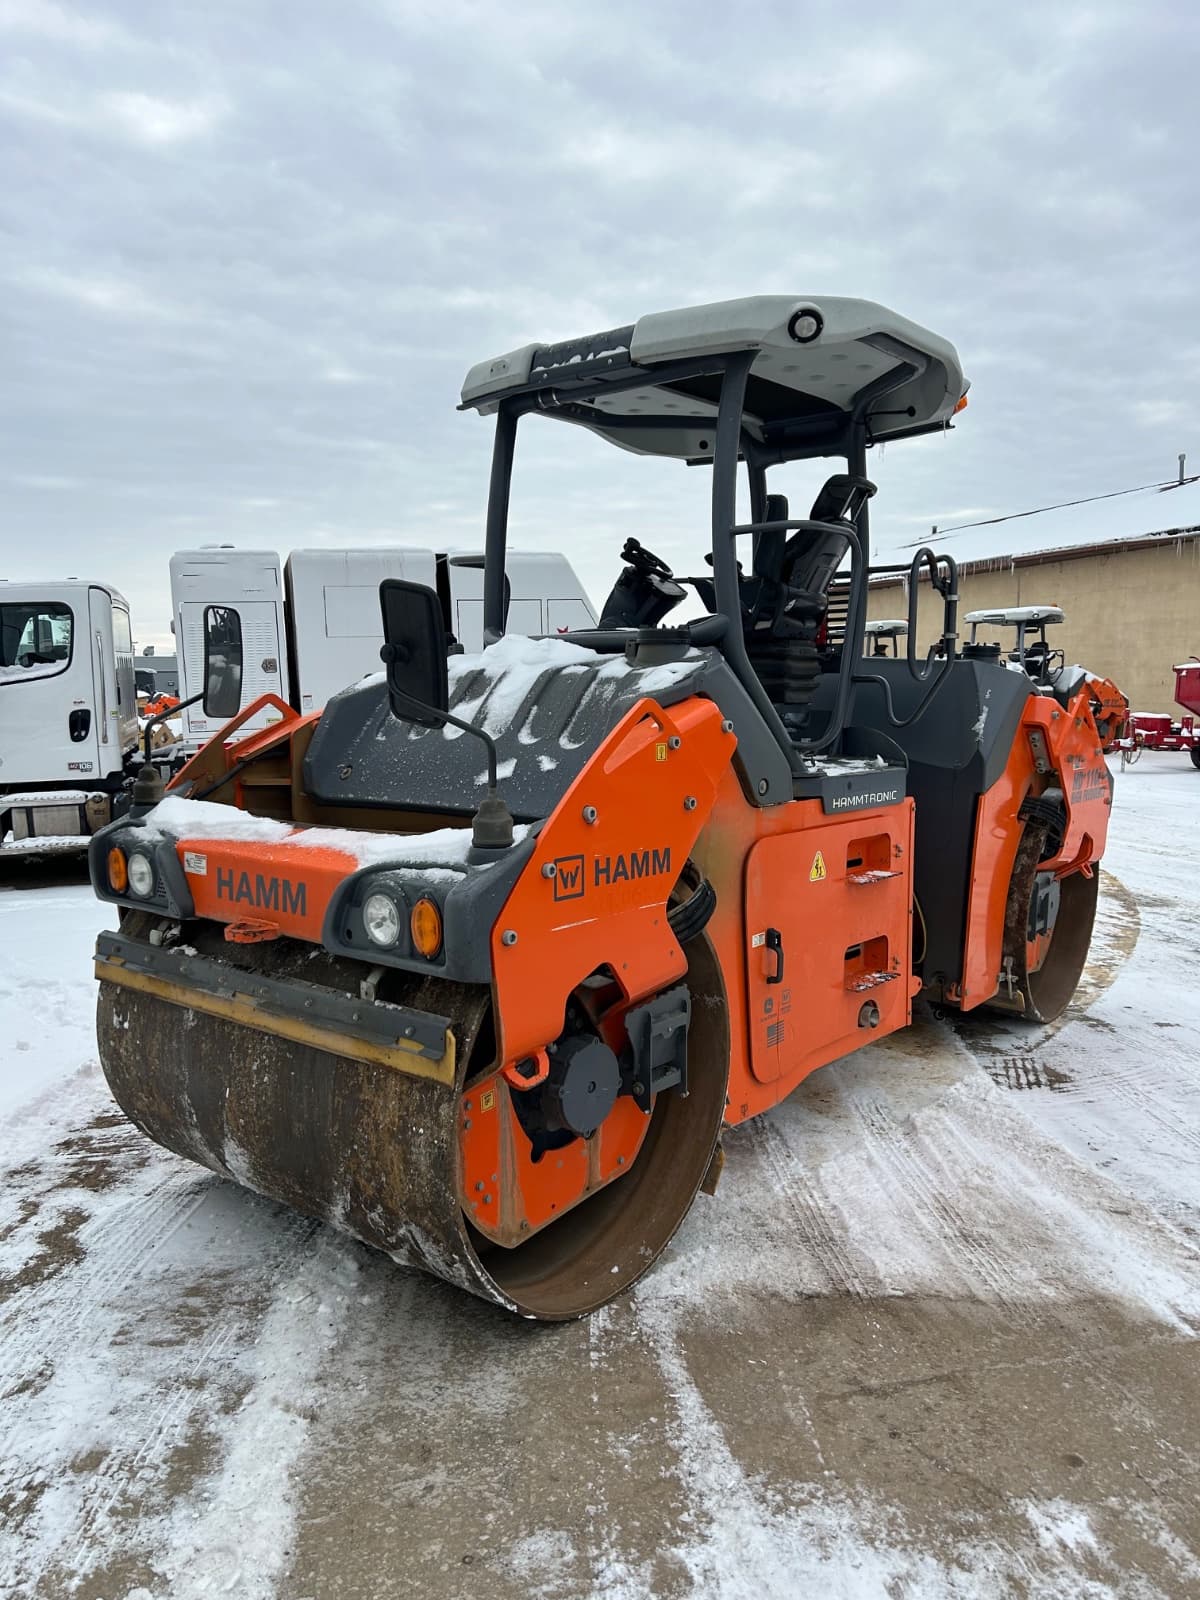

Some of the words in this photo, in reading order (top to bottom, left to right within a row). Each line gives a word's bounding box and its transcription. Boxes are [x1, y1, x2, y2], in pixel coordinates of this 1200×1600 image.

[832, 790, 898, 809] HAMMTRONIC
[594, 847, 671, 887] HAMM
[216, 866, 307, 917] HAMM
